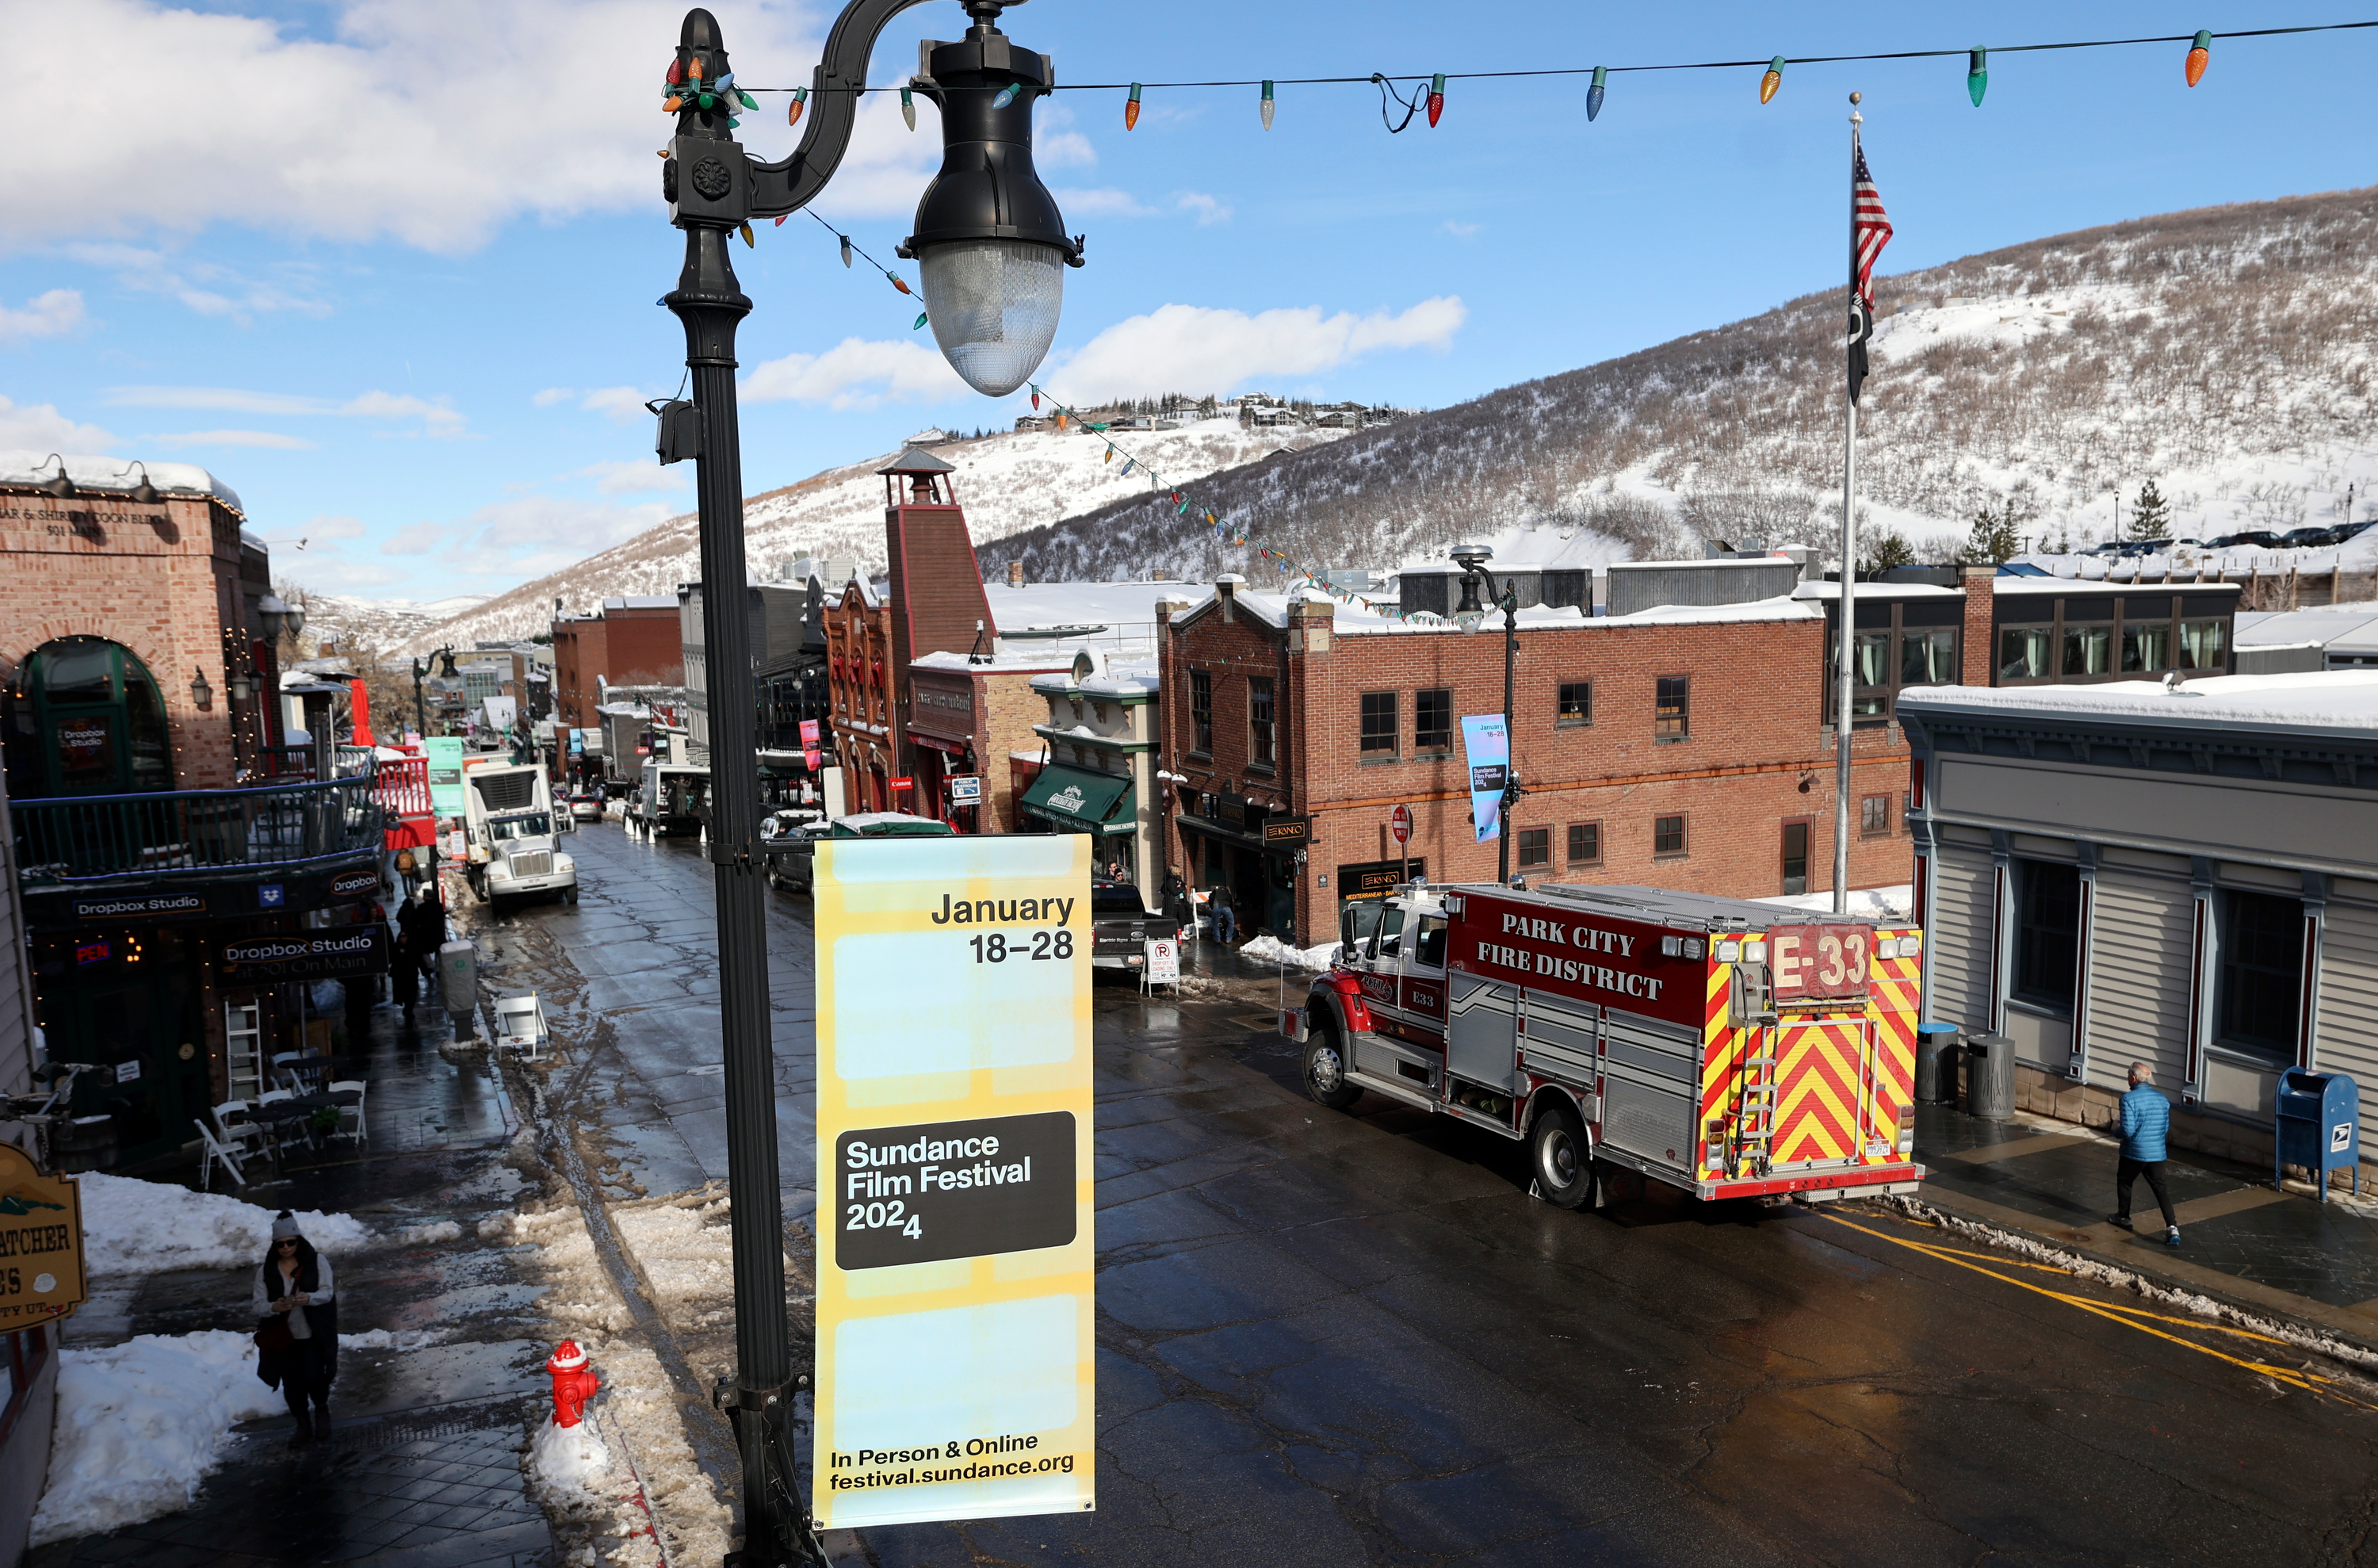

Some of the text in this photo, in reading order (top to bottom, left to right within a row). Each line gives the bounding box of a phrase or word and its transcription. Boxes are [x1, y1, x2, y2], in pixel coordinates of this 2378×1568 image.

[23, 511, 36, 520] &
[93, 513, 128, 524] COON
[47, 525, 101, 537] 501 MAIN
[65, 729, 106, 739] Dropbox
[70, 737, 103, 747] Studio
[1059, 814, 1072, 825] FUDGE
[1278, 825, 1302, 836] KANEO
[334, 876, 377, 892] Dropbox
[1374, 874, 1397, 885] KANEO
[78, 897, 199, 915] Dropbox Studio
[1345, 891, 1382, 900] MEDITERRANEAN
[931, 893, 1075, 927] January
[1501, 912, 1635, 958] PARK CITY
[226, 936, 373, 960] Dropbox Studio
[969, 930, 1073, 963] 18–28
[258, 962, 286, 978] 501
[291, 959, 320, 973] On
[325, 956, 366, 969] Main
[1477, 941, 1663, 1000] FIRE DISTRICT
[1774, 934, 1866, 988] E-33
[1413, 990, 1434, 1007] E33
[846, 1134, 1000, 1168] Sundance
[847, 1156, 1030, 1200] Film Festival
[846, 1199, 923, 1240] 2024
[831, 1433, 1038, 1467] In Person & Online
[830, 1454, 1074, 1490] festival.sundance.org
